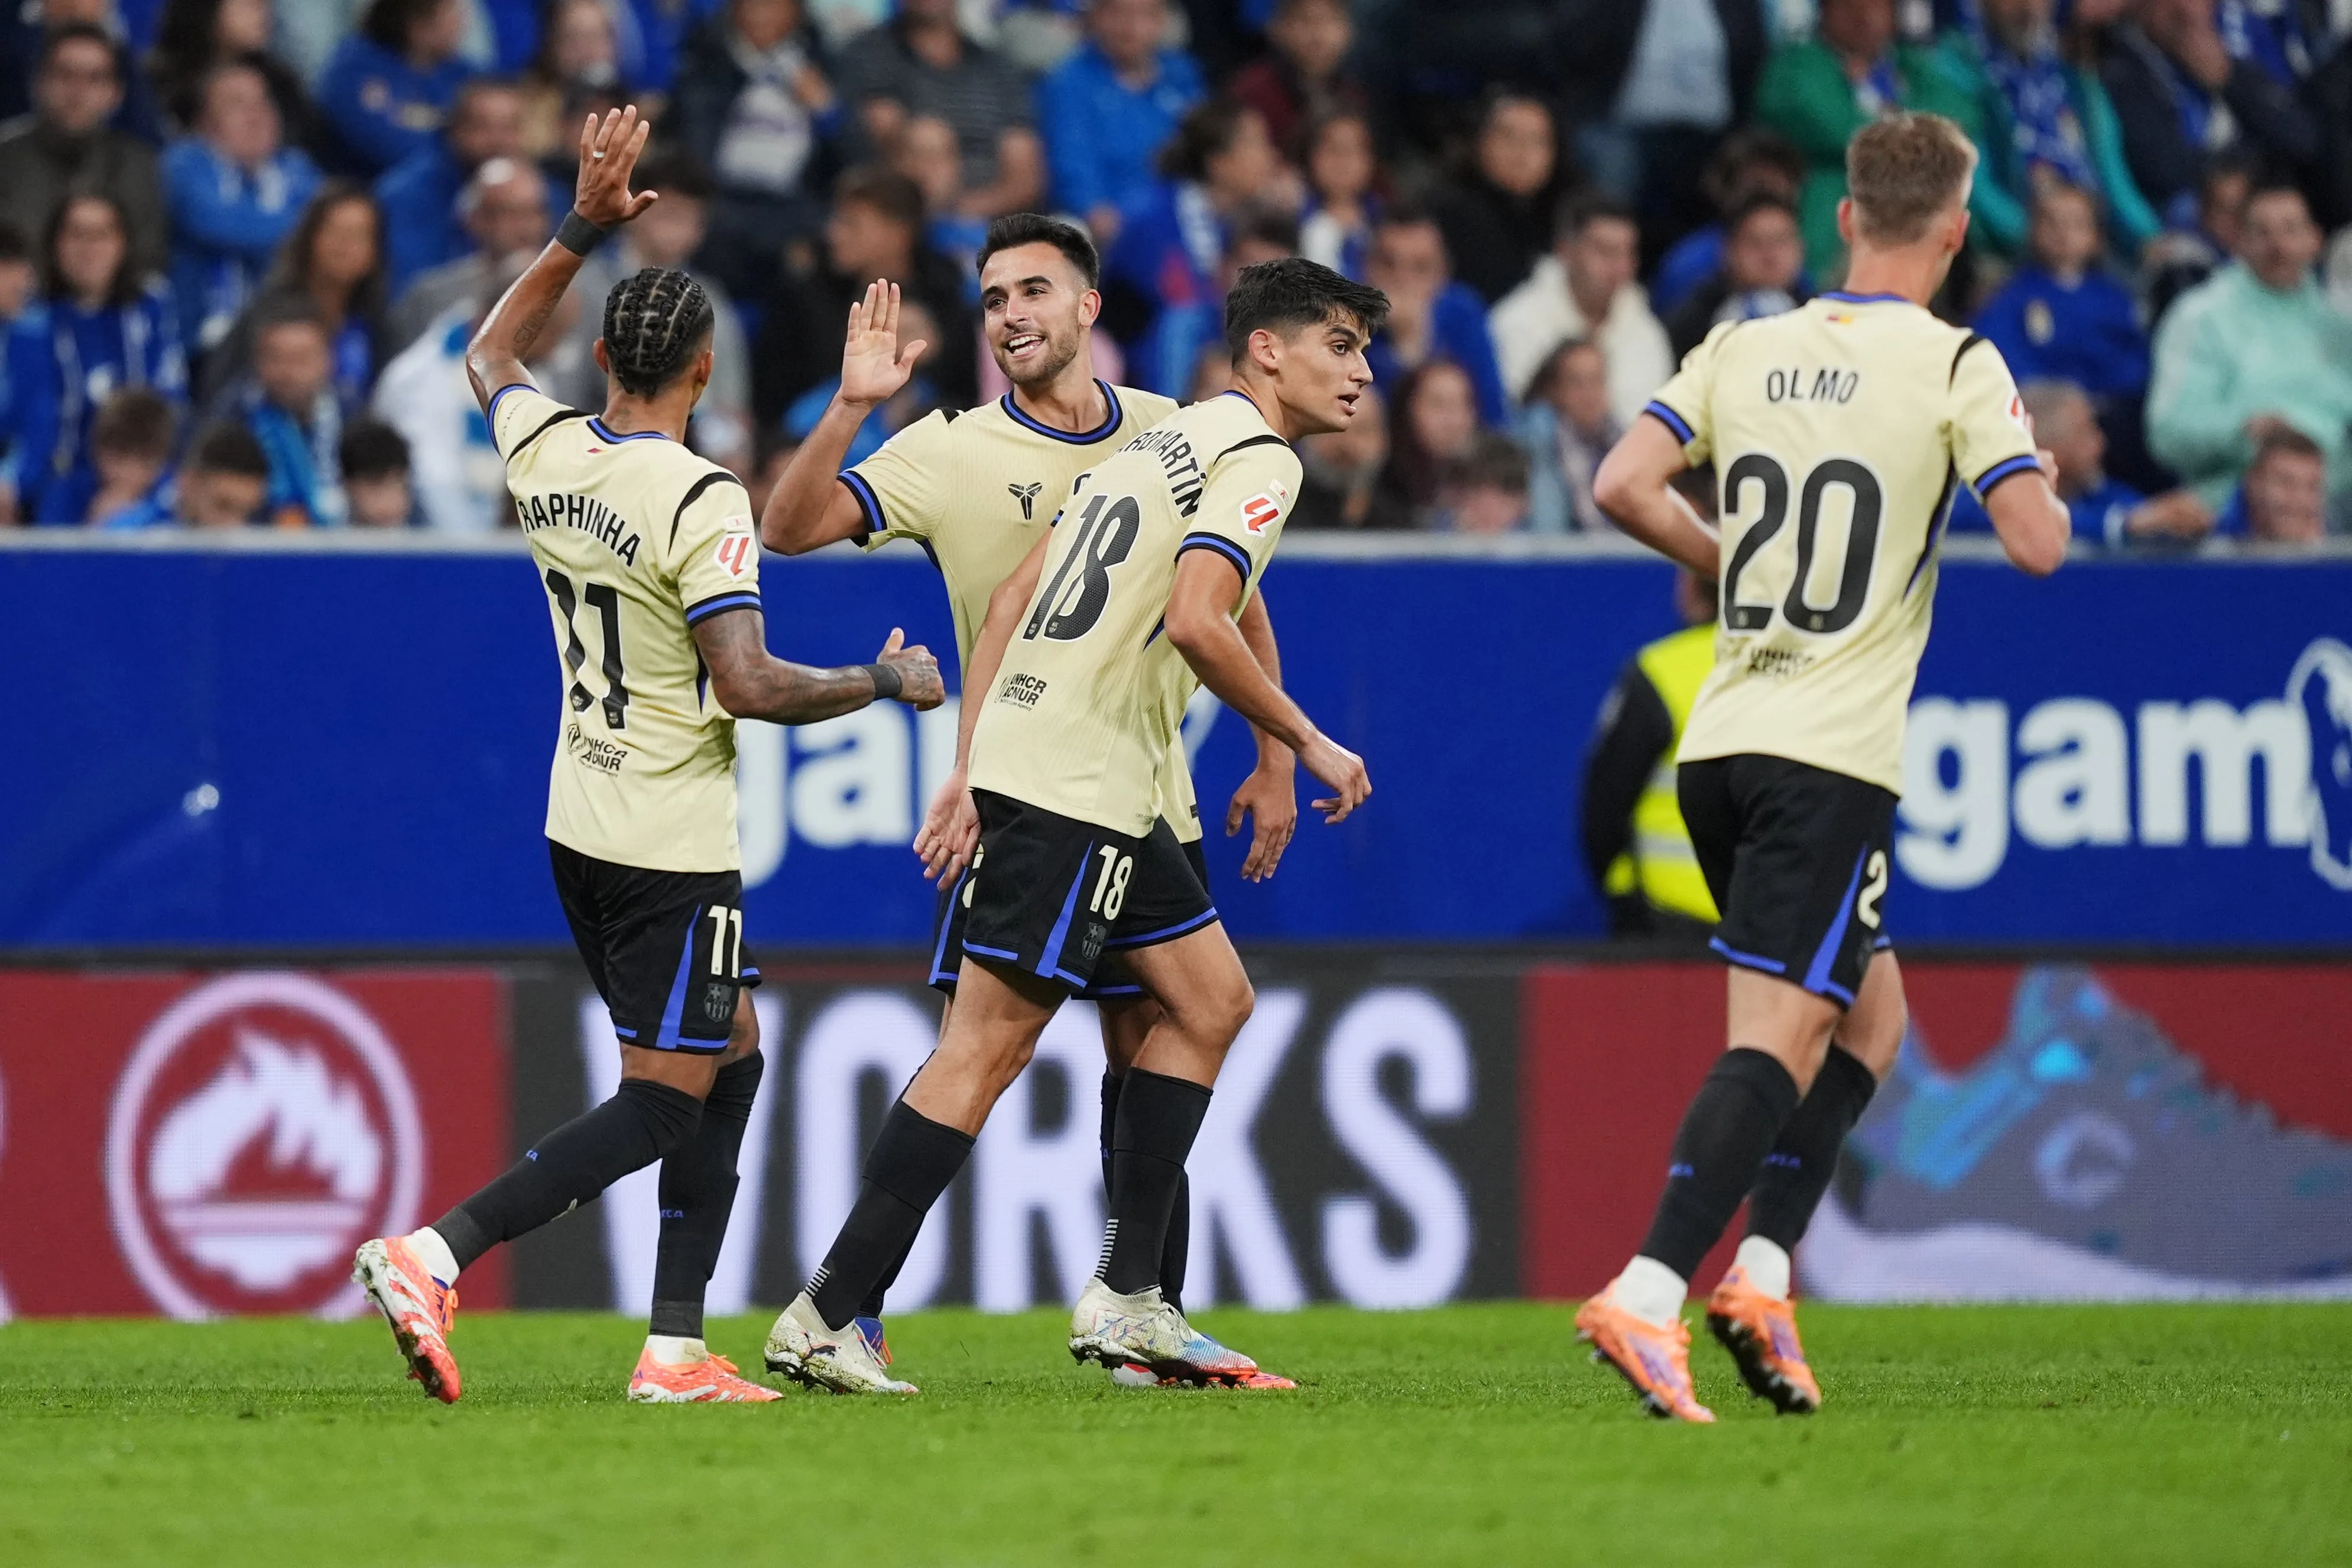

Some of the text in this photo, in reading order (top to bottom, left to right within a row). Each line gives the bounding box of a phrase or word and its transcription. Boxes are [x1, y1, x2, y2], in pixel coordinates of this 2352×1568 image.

[1767, 369, 1859, 404] OLMO
[518, 493, 641, 567] RAPHINHA
[1023, 495, 1140, 640] 18
[1724, 455, 1881, 634] 20
[546, 568, 630, 729] 11
[1894, 696, 2312, 891] gam
[708, 905, 742, 979] 11
[1089, 844, 1133, 921] 18
[577, 985, 1472, 1311] WORKS
